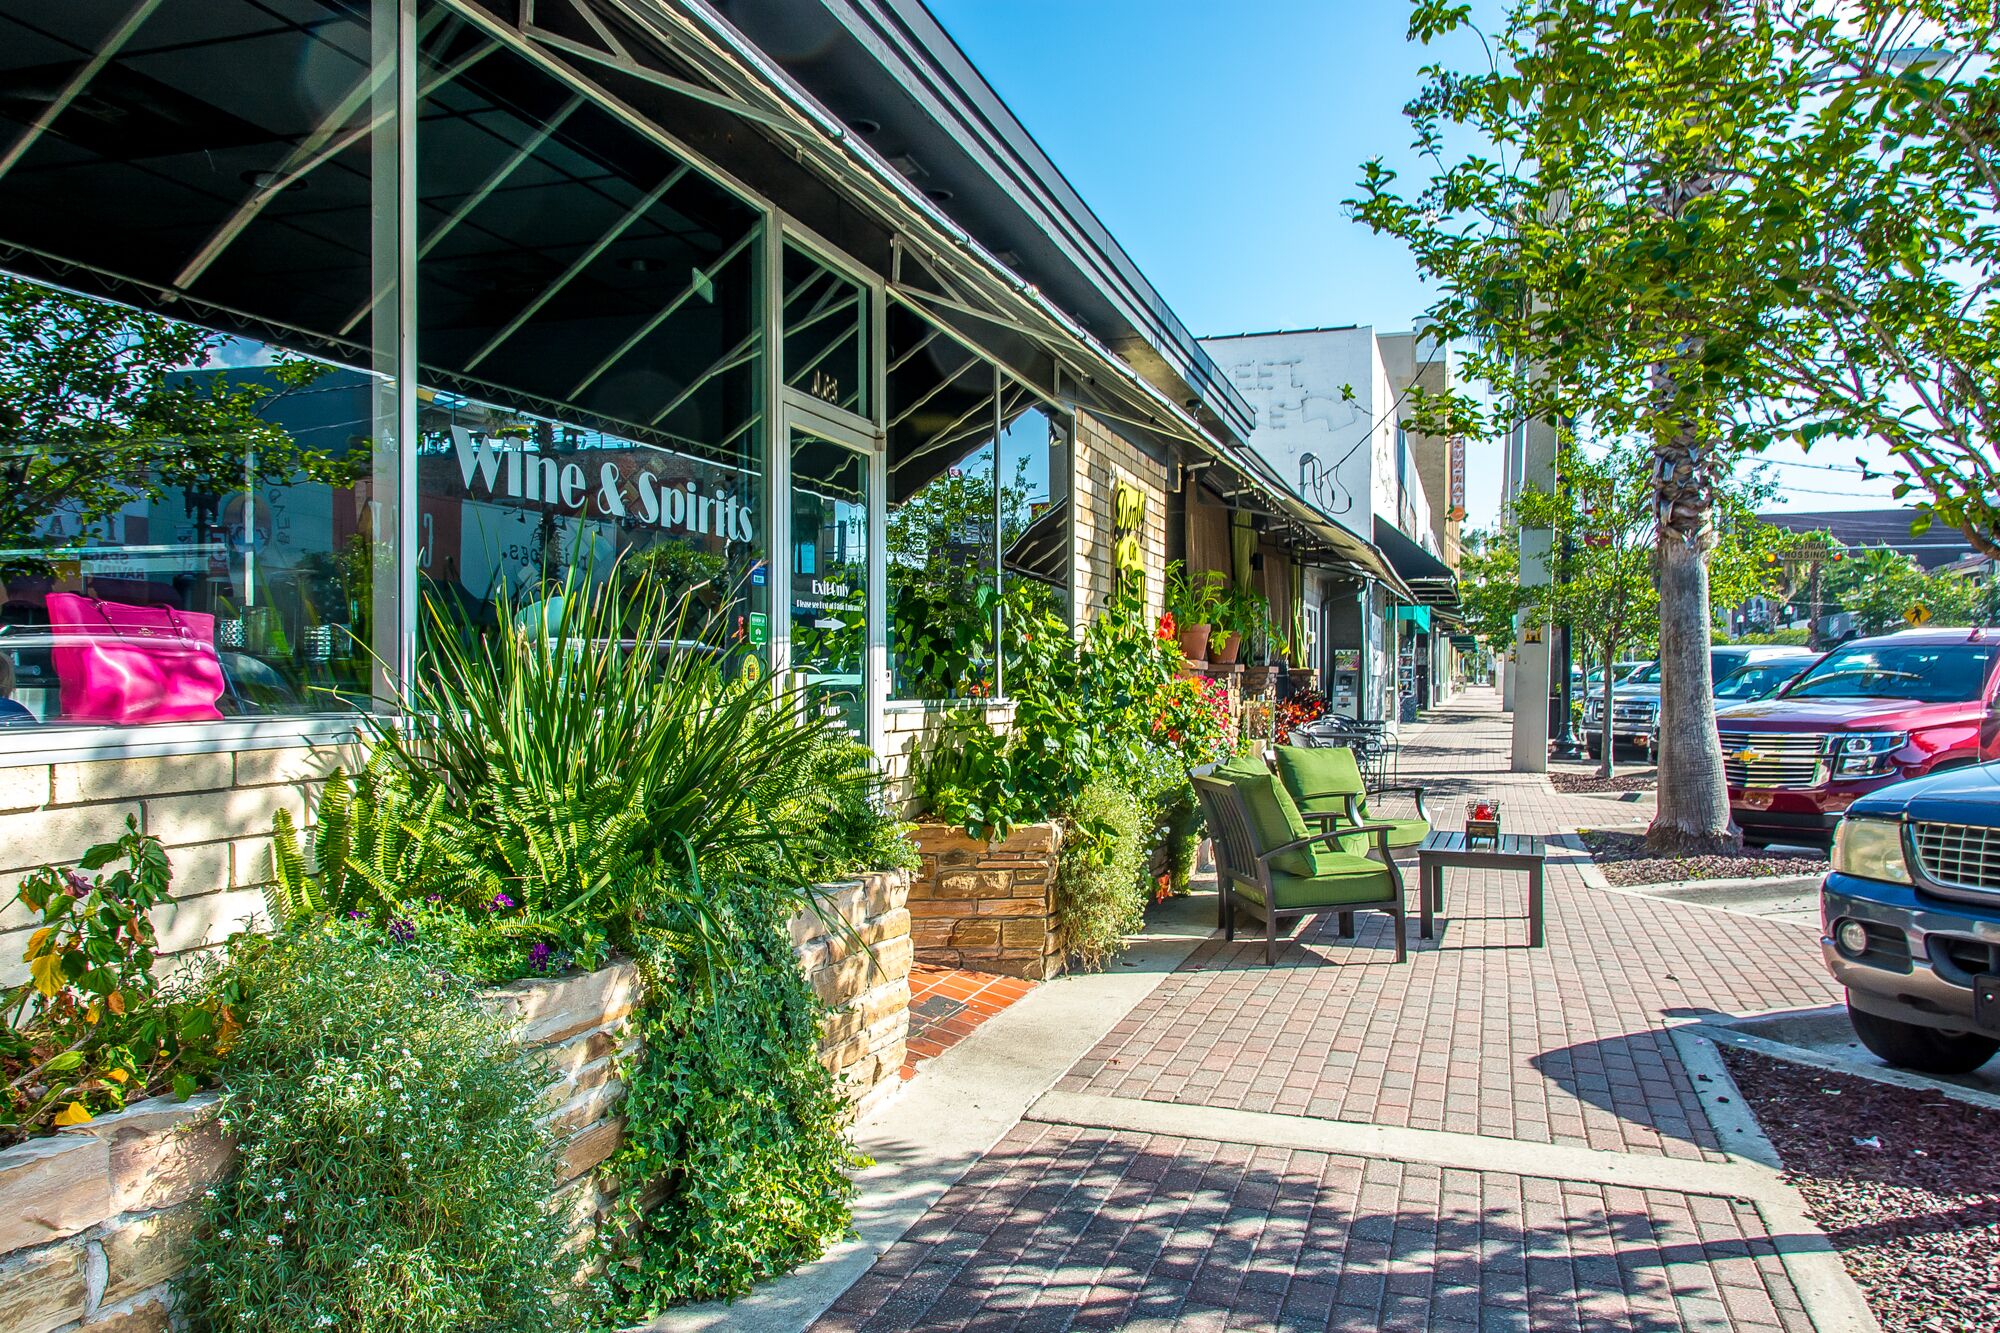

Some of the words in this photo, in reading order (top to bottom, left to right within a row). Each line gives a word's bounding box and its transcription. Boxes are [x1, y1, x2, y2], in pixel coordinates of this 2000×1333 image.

[450, 424, 586, 509] Wine
[598, 462, 627, 517] &
[638, 471, 753, 543] Spirits
